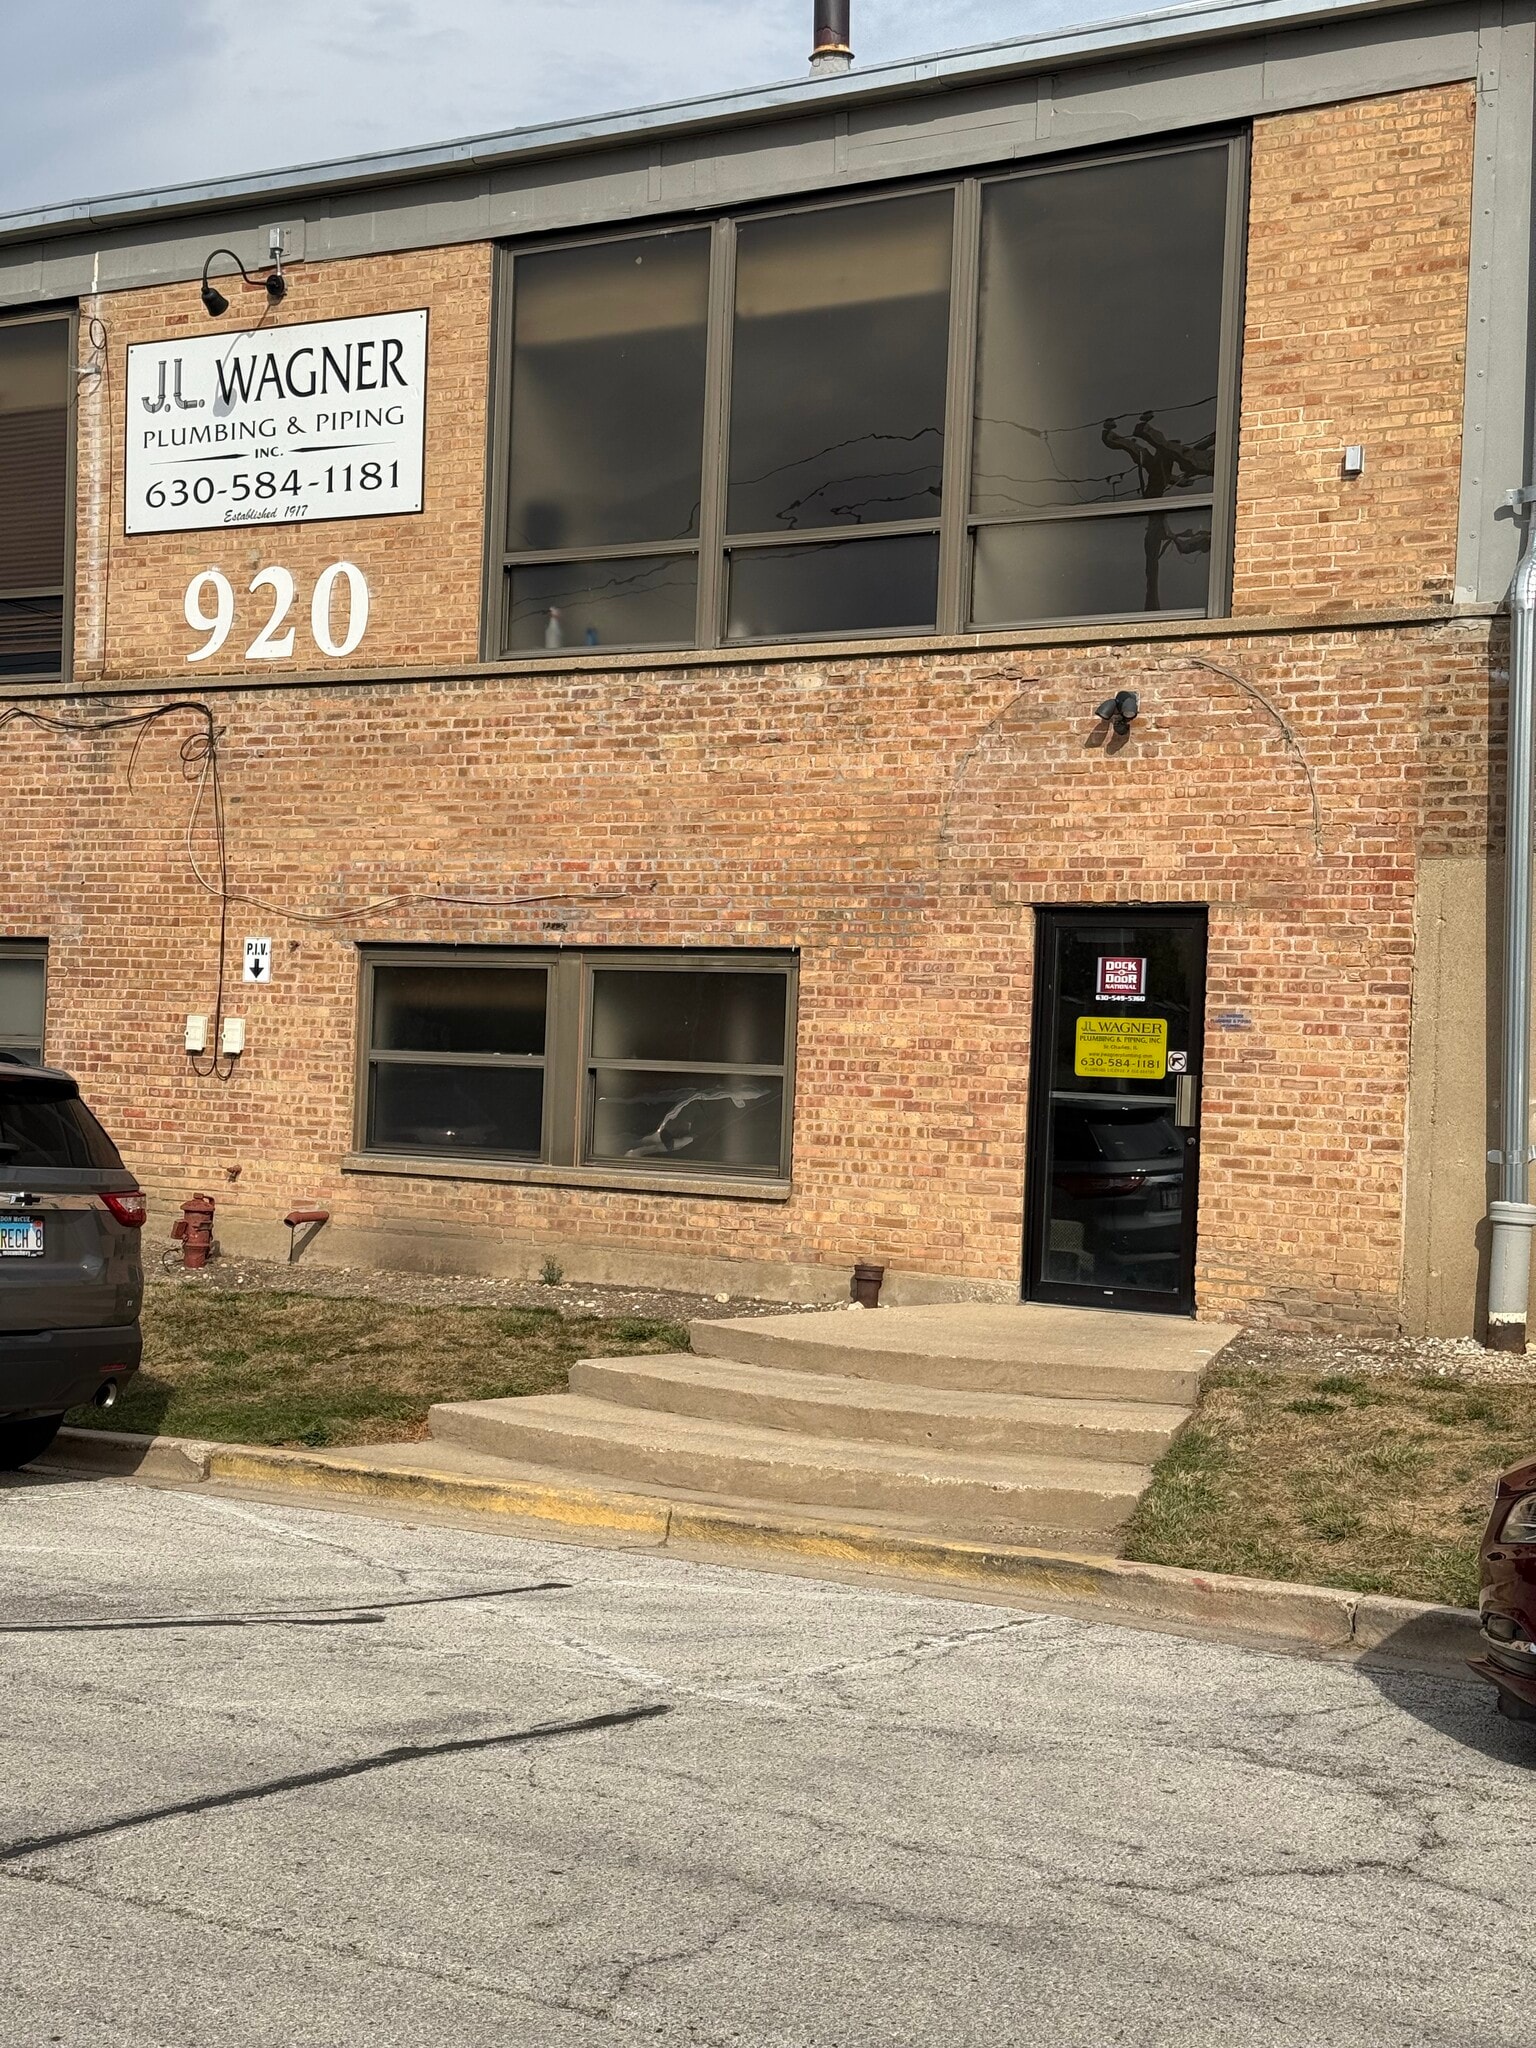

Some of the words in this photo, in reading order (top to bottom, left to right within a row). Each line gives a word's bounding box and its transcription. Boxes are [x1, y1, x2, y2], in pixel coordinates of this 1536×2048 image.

[141, 358, 205, 414] J.L.
[215, 338, 408, 407] WAGNER
[143, 418, 277, 449] PLUMBING
[287, 416, 307, 435] &
[316, 405, 405, 433] PIPING
[254, 446, 284, 459] INC.
[145, 459, 400, 508] 630-584-1181
[223, 507, 278, 524] Established
[284, 504, 309, 519] 1917
[184, 561, 370, 663] 920
[246, 942, 268, 956] P.I.V.
[1105, 961, 1137, 971] DOCK
[1105, 973, 1137, 984] DOOR
[1098, 1021, 1162, 1034] WAGNER
[1079, 1035, 1115, 1043] PLUMBING
[1080, 1057, 1160, 1069] 630-584-1181
[0, 1229, 29, 1248] RECH
[36, 1229, 42, 1248] 8
